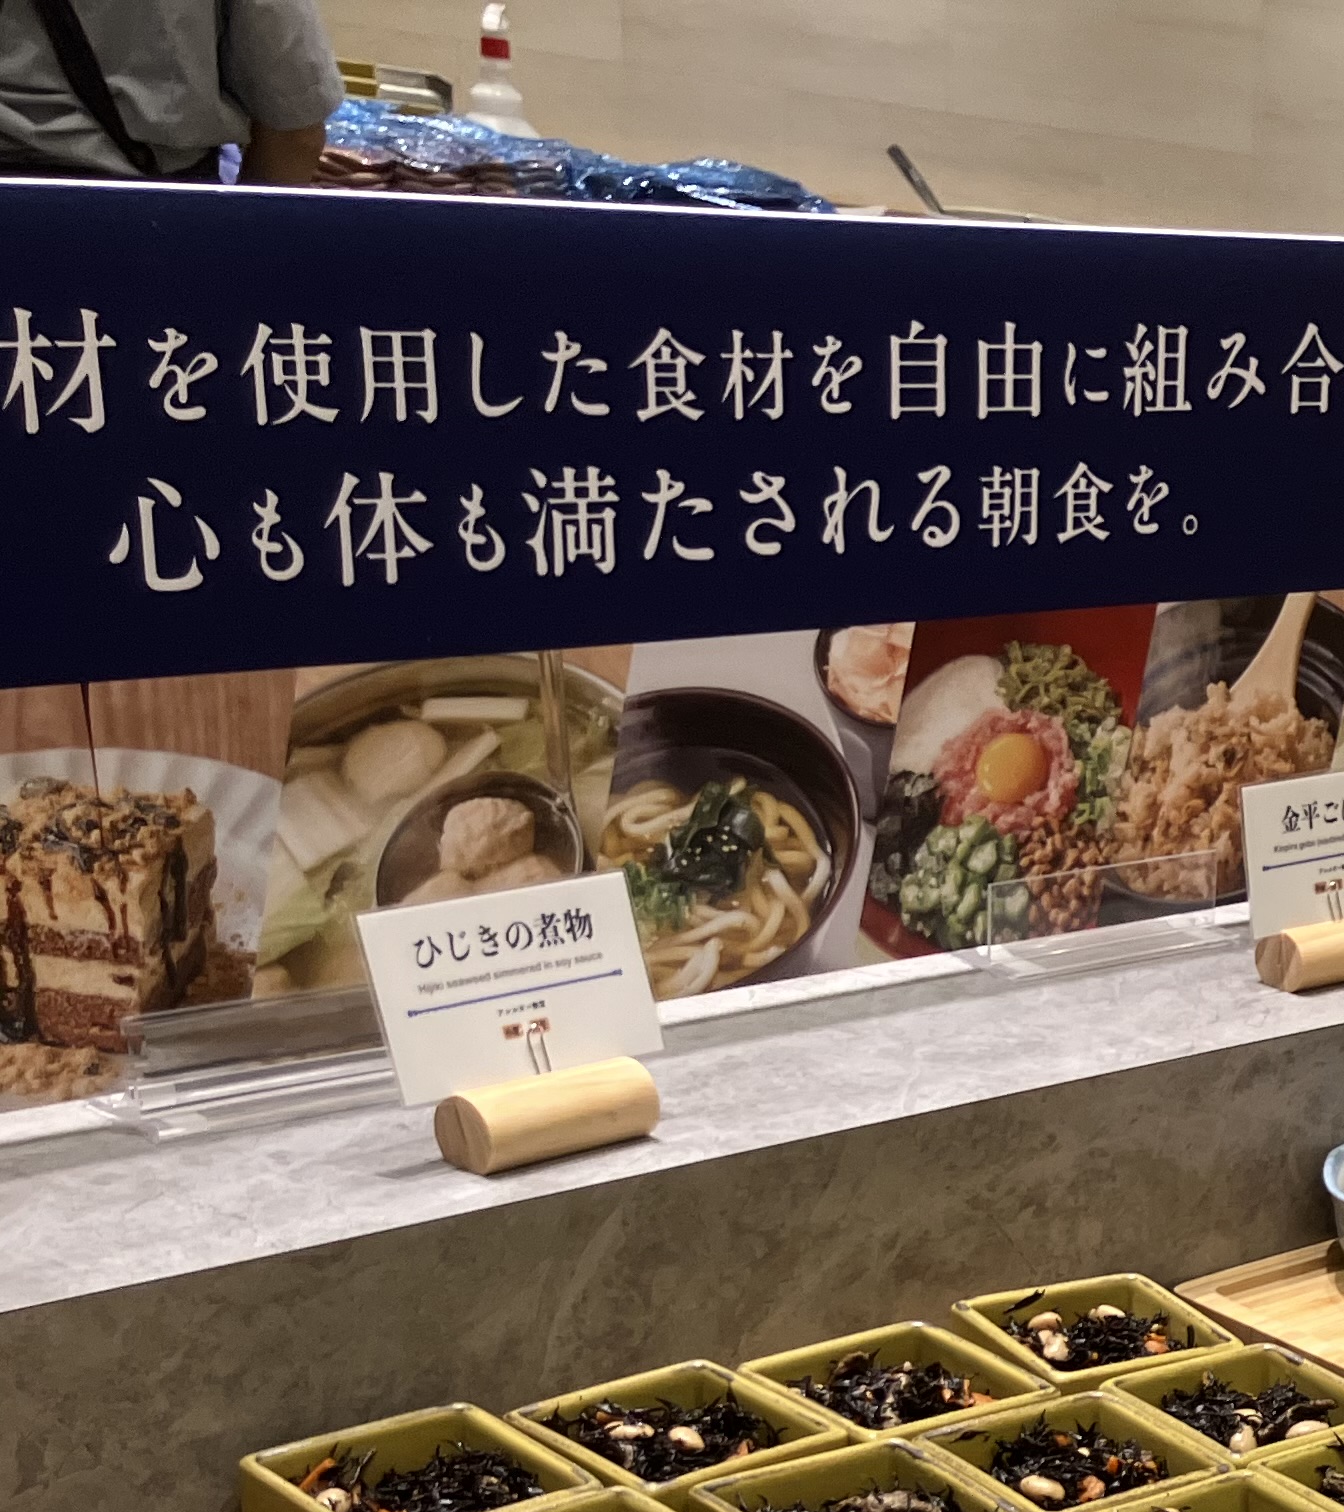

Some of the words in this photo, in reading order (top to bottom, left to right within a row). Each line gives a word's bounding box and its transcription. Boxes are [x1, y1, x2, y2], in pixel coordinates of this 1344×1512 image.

[108, 461, 1201, 593] 心も体も満たされる朝食を。
[413, 907, 594, 969] ひじきの煮物
